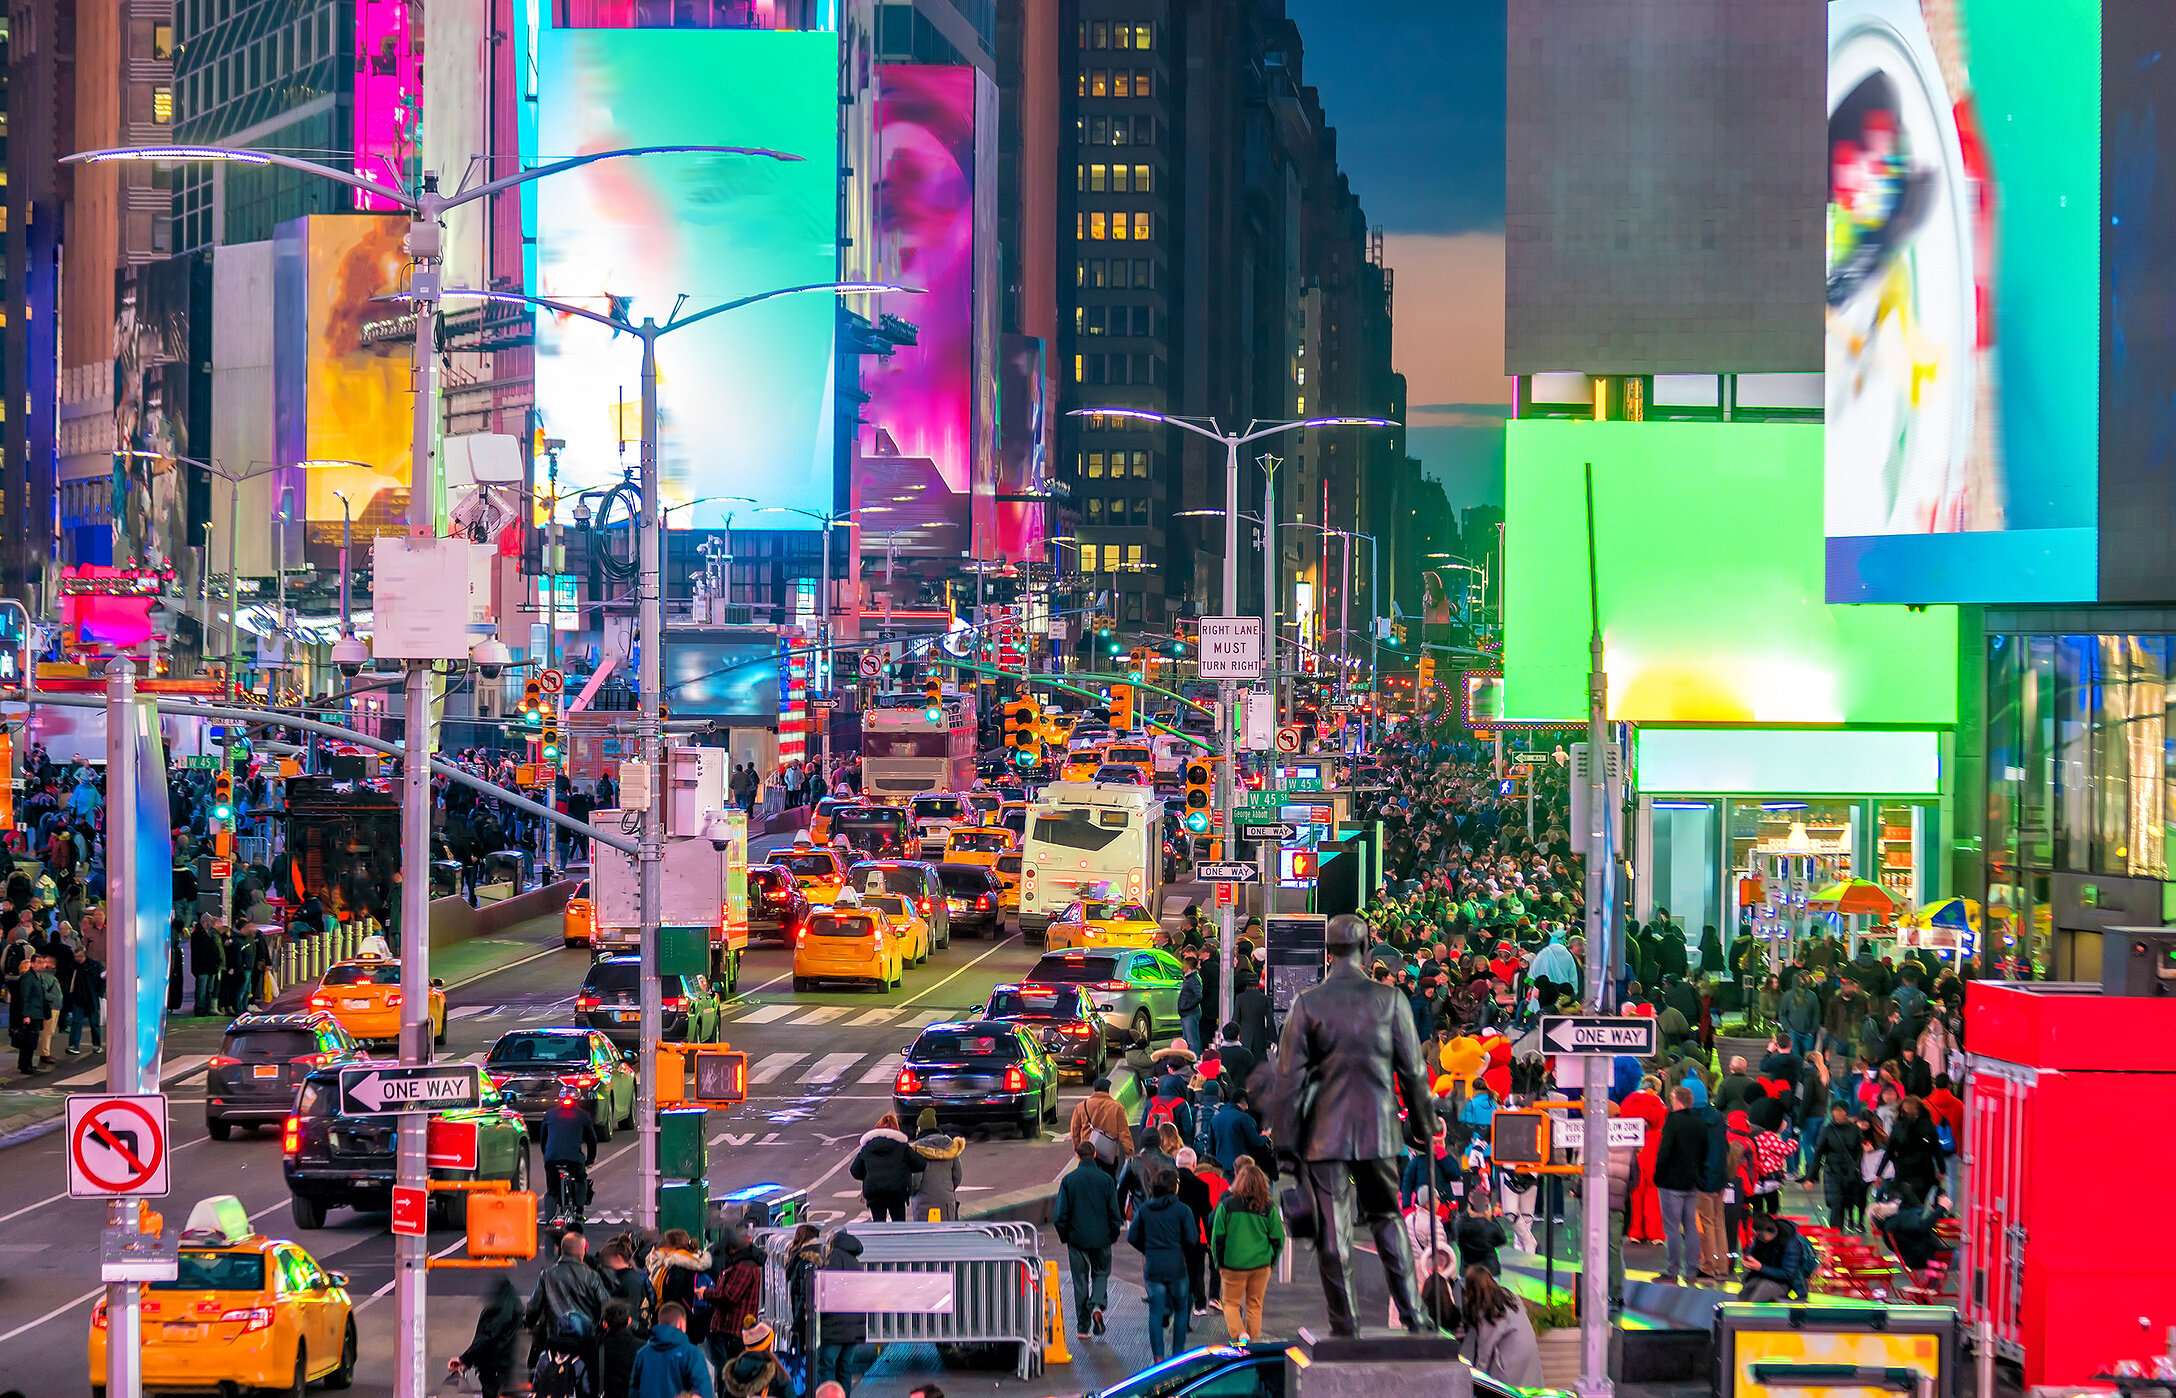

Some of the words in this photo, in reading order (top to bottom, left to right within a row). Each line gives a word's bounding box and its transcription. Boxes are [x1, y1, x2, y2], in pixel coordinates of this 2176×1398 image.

[1202, 625, 1230, 635] RIGHT
[1234, 625, 1259, 635] LANE
[1213, 642, 1247, 654] MUST
[1202, 661, 1226, 671] TURN
[1231, 661, 1259, 671] RIGHT
[188, 757, 197, 767] W
[200, 757, 211, 768] 45
[1288, 779, 1297, 789] W
[1300, 779, 1312, 789] 45
[1249, 793, 1260, 805] W
[1263, 793, 1277, 805] 45
[1280, 793, 1288, 801] St
[1233, 810, 1251, 820] George
[1252, 810, 1268, 818] Abbott
[1205, 867, 1224, 876] ONE
[1231, 867, 1250, 876] WAY
[1575, 1029, 1606, 1044] ONE
[1611, 1029, 1642, 1044] WAY
[383, 1081, 420, 1099] ONE
[426, 1079, 464, 1098] WAY
[1565, 1122, 1585, 1133] PEDES
[706, 1132, 863, 1146] NLY
